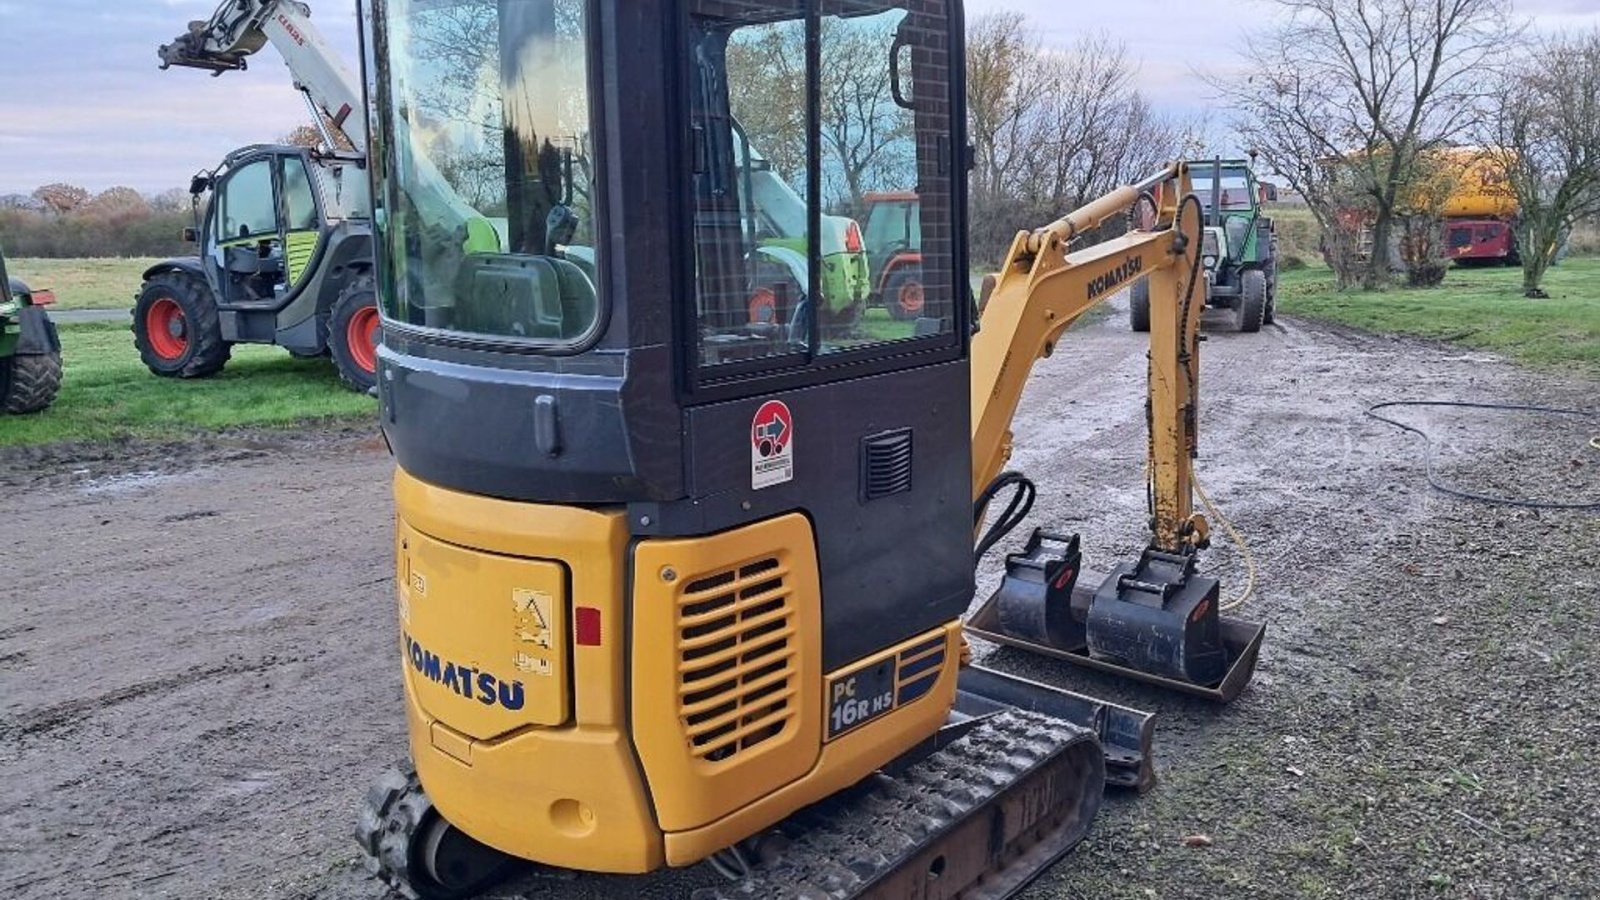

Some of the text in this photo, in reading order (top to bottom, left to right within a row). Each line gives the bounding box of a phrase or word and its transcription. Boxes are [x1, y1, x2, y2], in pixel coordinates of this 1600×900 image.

[276, 15, 306, 46] CLAAS
[1087, 256, 1142, 299] KOMATSU
[404, 631, 524, 710] KOMATSU
[834, 677, 856, 703] PC
[832, 691, 893, 730] 16R HS
